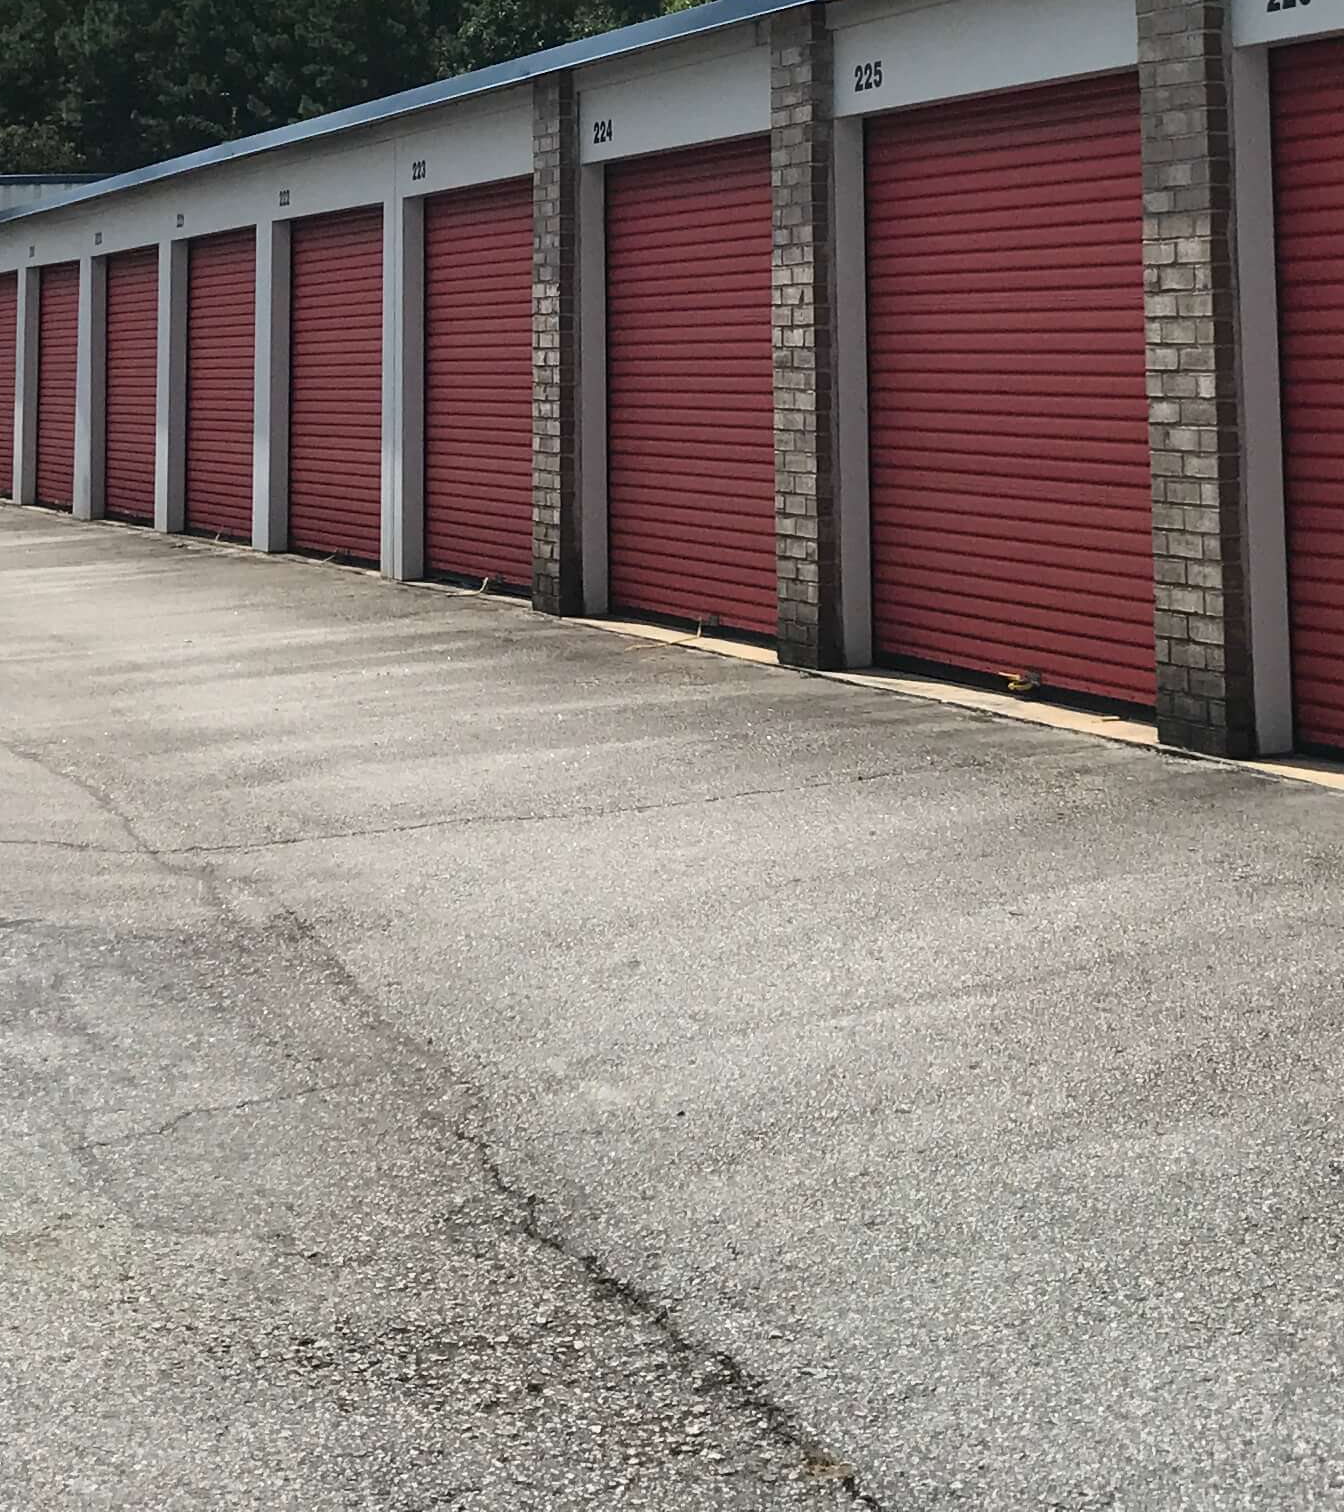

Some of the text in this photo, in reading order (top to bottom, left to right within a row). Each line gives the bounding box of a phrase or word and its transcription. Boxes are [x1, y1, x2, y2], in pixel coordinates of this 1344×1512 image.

[854, 60, 883, 92] 225
[593, 119, 613, 144] 224
[412, 159, 426, 181] 223
